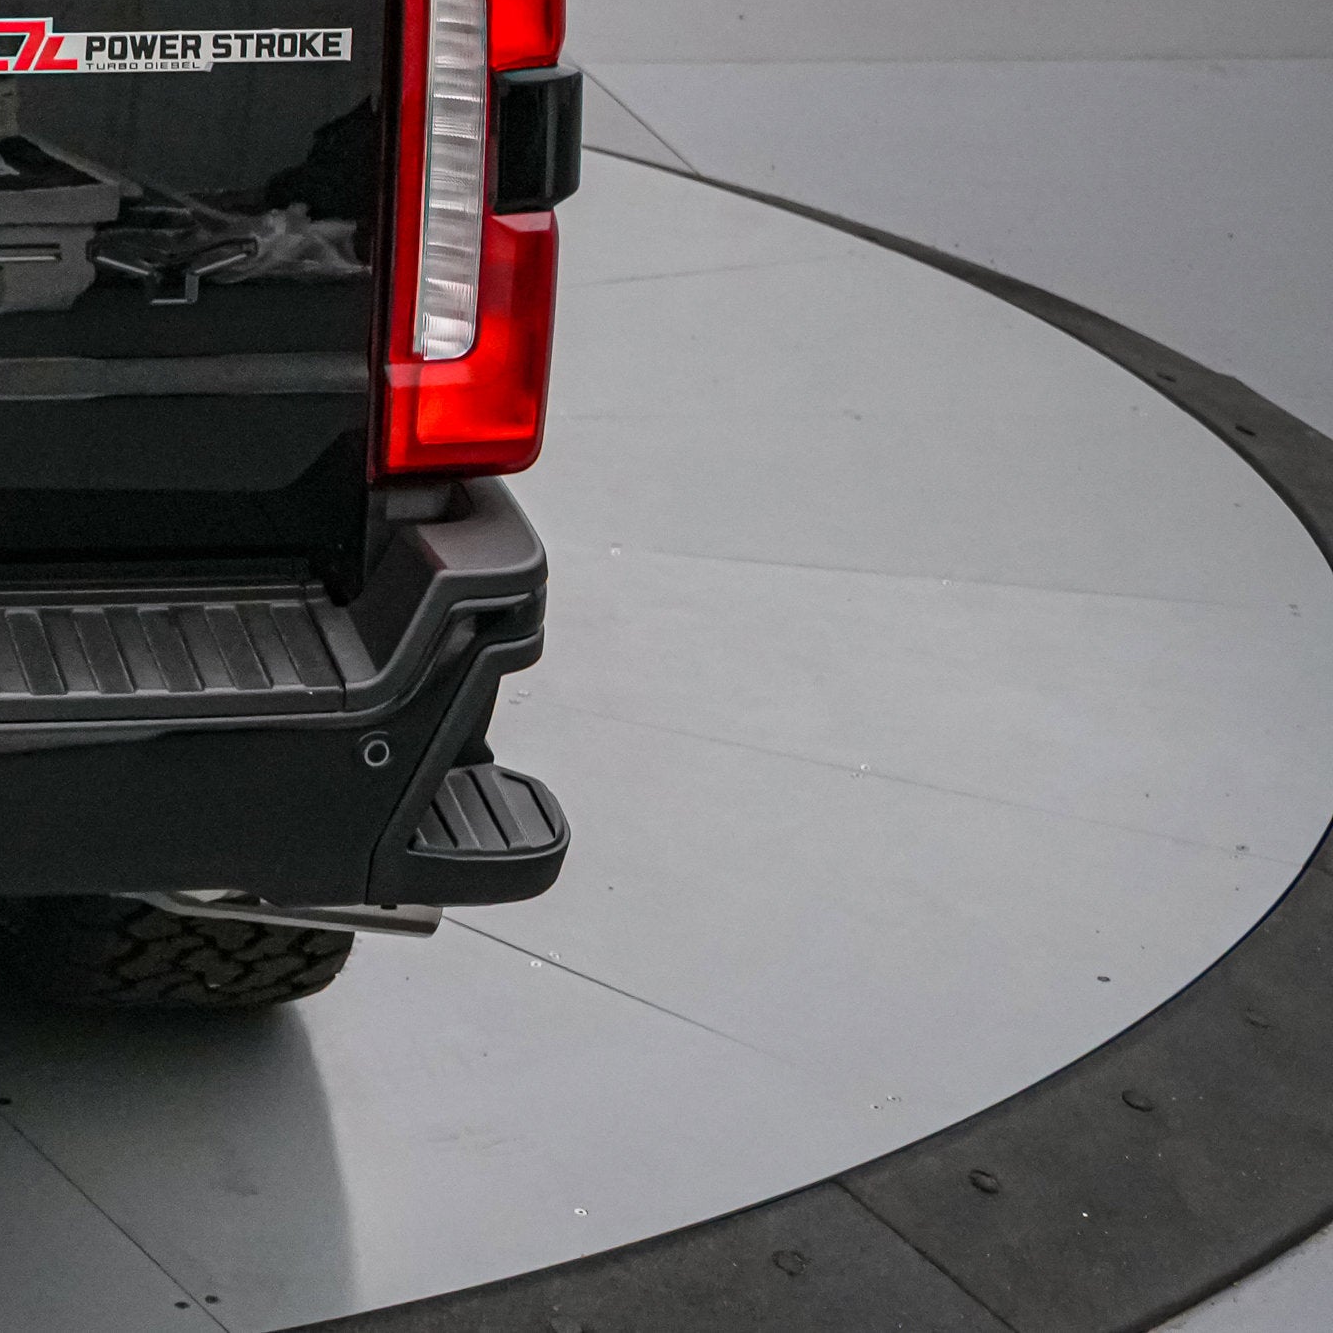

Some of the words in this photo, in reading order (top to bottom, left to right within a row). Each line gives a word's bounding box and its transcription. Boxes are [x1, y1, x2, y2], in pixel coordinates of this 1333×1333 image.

[85, 35, 201, 61] POWER
[211, 31, 342, 59] STROKE
[85, 62, 139, 71] TURBO
[144, 61, 201, 70] DIESEL
